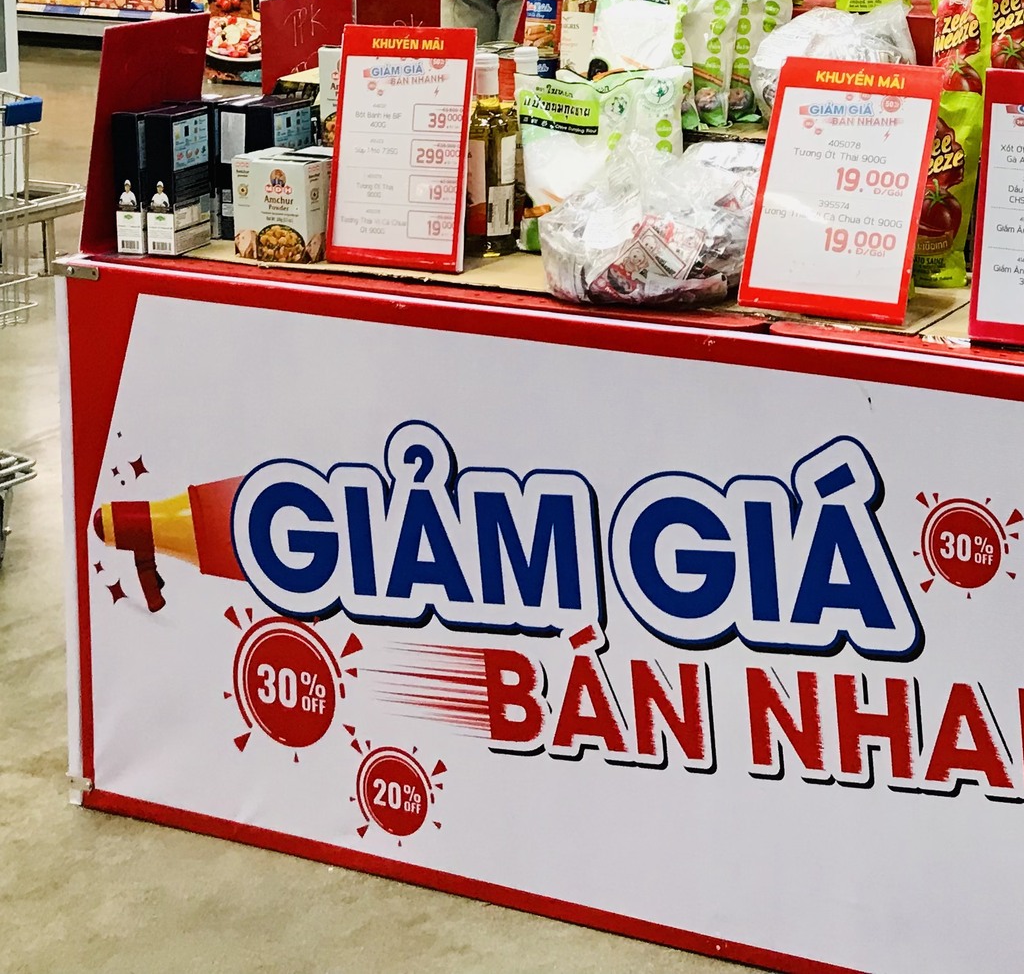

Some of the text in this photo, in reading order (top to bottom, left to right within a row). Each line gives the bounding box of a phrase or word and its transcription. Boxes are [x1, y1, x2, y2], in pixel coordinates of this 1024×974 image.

[372, 36, 444, 50] KHUYẾN MÃI
[816, 68, 905, 89] KHUYẾN MÃI
[828, 140, 861, 150] 405078
[861, 154, 887, 164] 900G
[264, 195, 293, 204] Amchur
[818, 199, 850, 210] 395574
[1009, 196, 1024, 204] CHS
[839, 214, 861, 225] Chua
[877, 218, 903, 229] 900G
[246, 442, 896, 630] GIẢM GIÁ
[973, 552, 994, 567] OFF
[300, 694, 327, 715] OFF
[484, 626, 715, 771] BÁN
[403, 798, 422, 815] OFF
